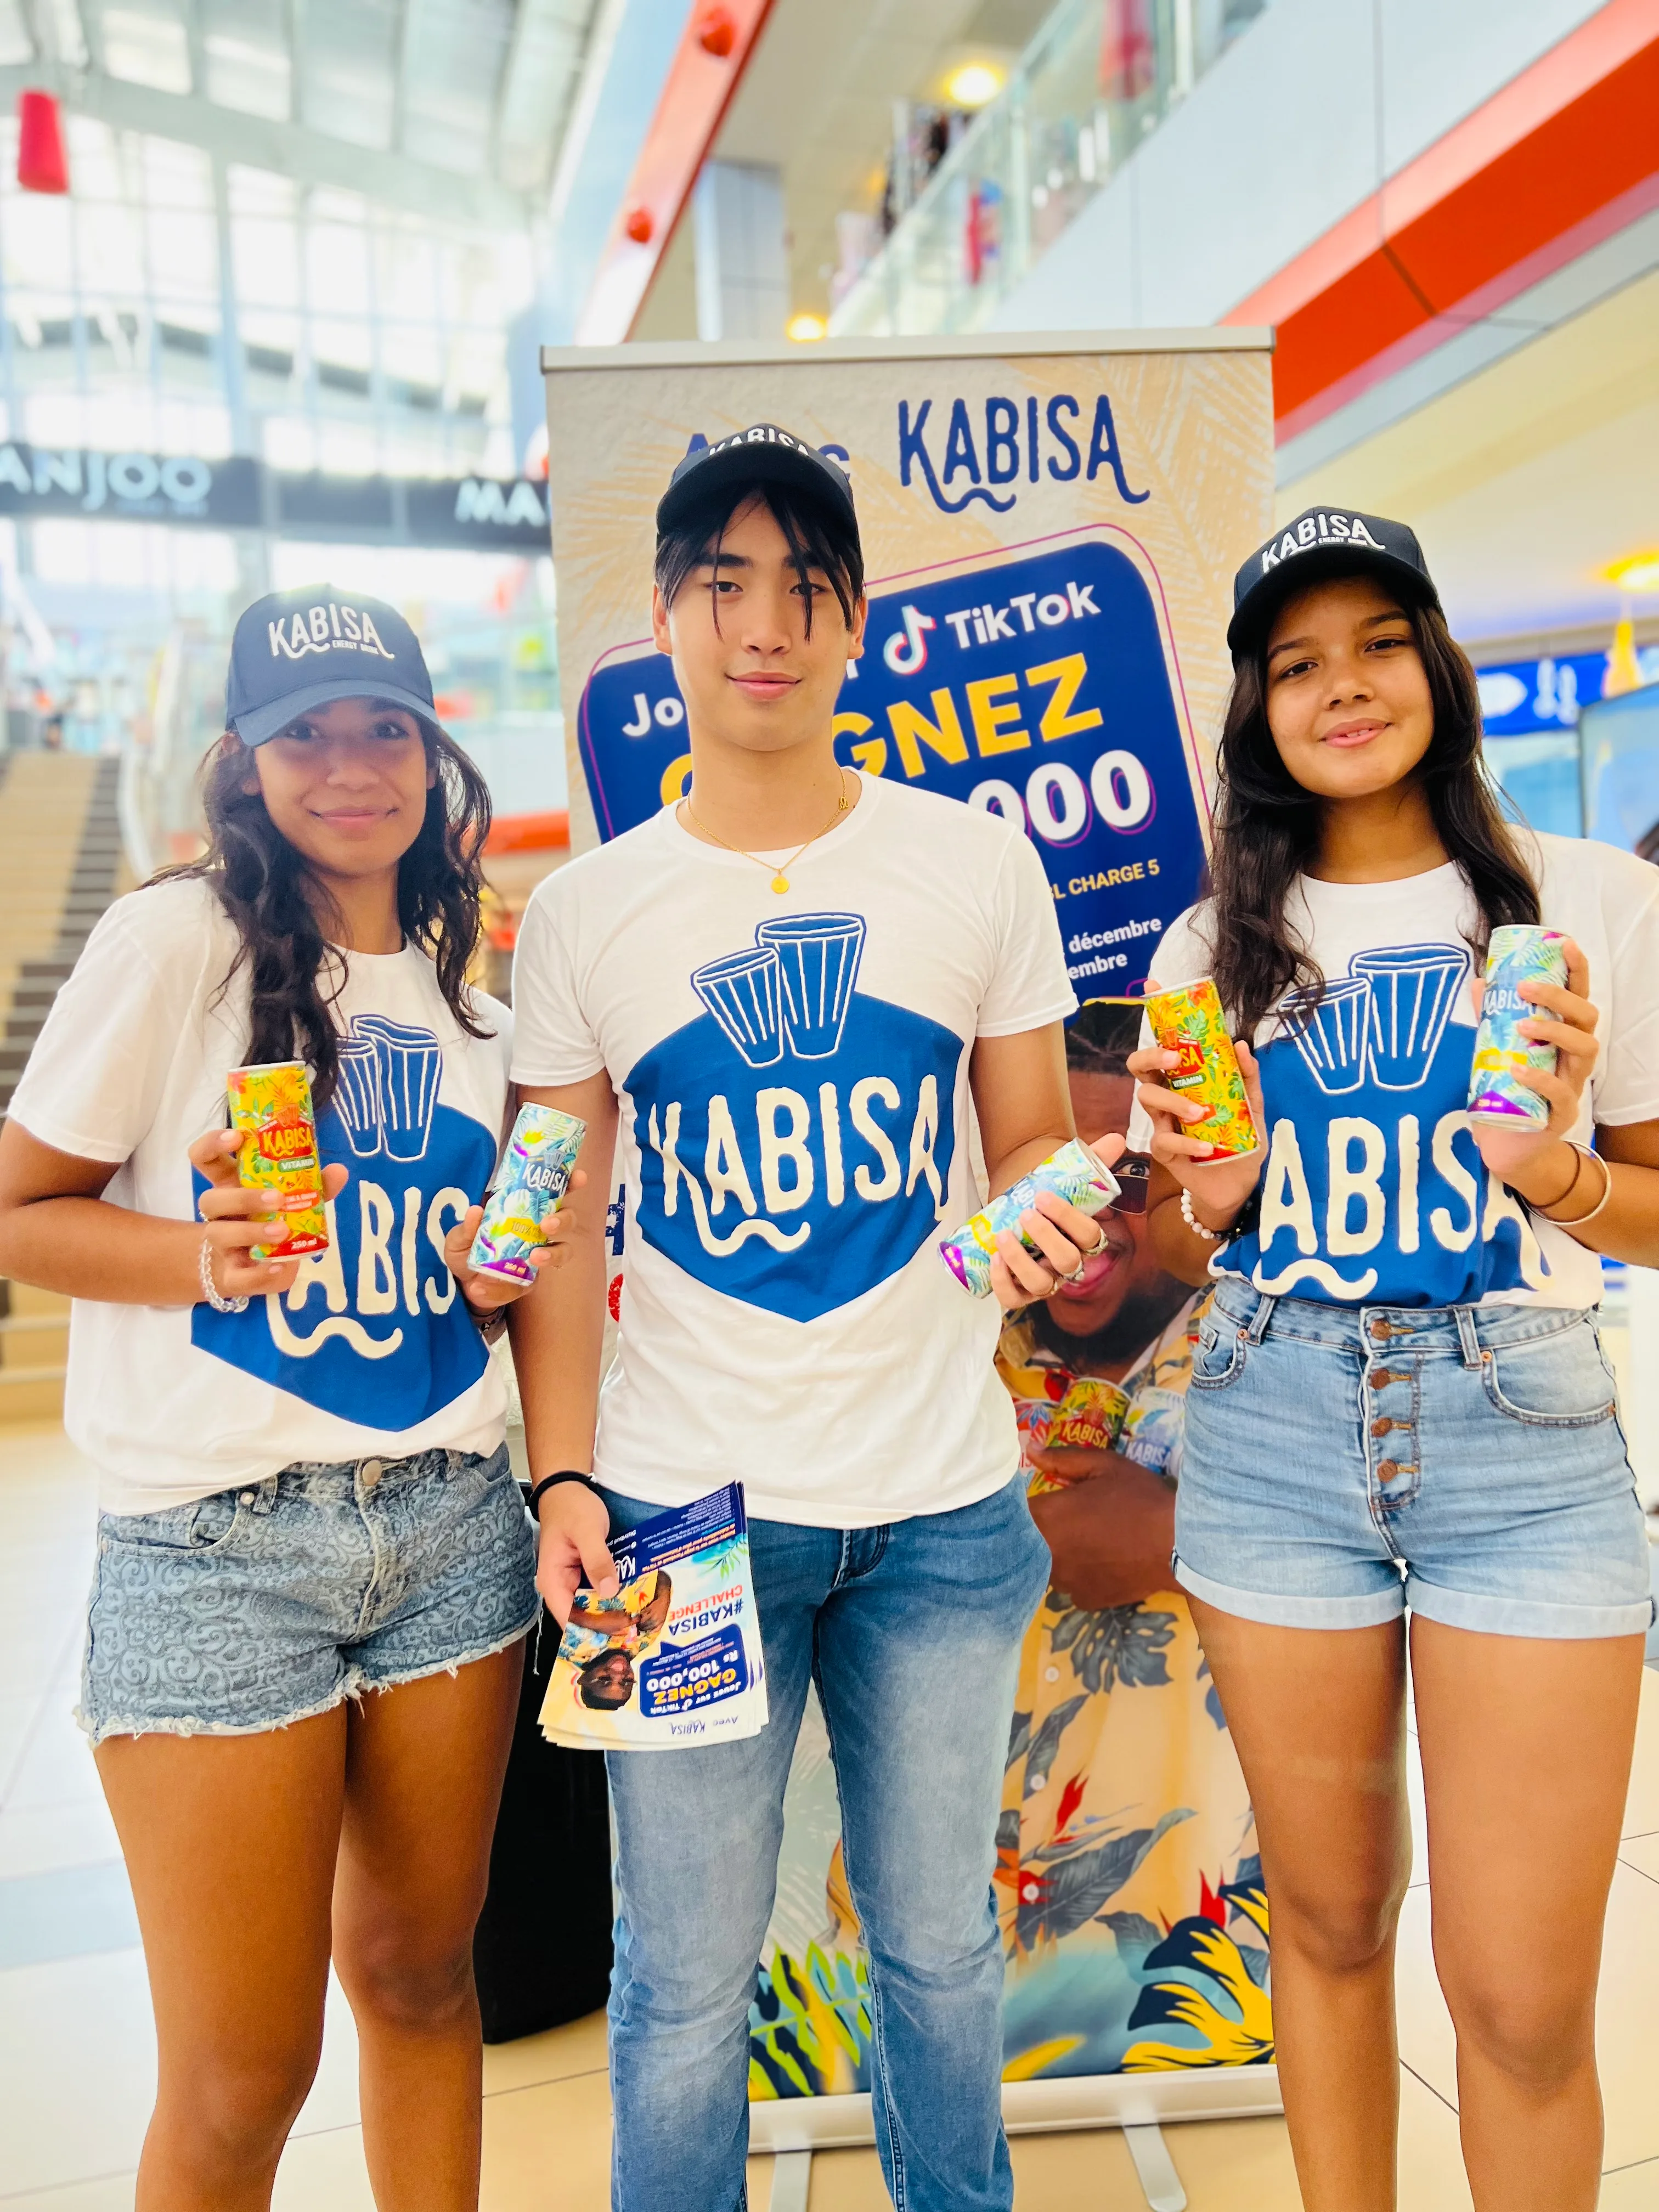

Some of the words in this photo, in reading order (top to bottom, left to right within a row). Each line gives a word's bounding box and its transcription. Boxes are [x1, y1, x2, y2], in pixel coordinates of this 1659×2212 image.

[898, 394, 1151, 514] KABISA
[1262, 514, 1386, 573] KABISA
[268, 603, 395, 658] KABISA
[945, 582, 1101, 650] TikTok
[332, 640, 358, 650] ENERGY
[1068, 862, 1146, 896] CHARGE
[1147, 859, 1160, 876] 5
[1068, 918, 1163, 954] décembre
[263, 1126, 313, 1156] KABISA
[281, 1158, 314, 1170] VITAMIN
[522, 1163, 568, 1198] KABISA
[648, 1074, 952, 1257] KABISA
[1062, 1421, 1109, 1449] KABISA
[668, 1584, 743, 1622] CHALLENGE
[669, 1598, 744, 1636] #KABISA
[723, 1650, 738, 1663] Rs
[646, 1659, 720, 1692] 100,000
[653, 1668, 736, 1705] GAGNEZ
[669, 1719, 706, 1735] KABISA
[713, 1715, 738, 1726] Avec
